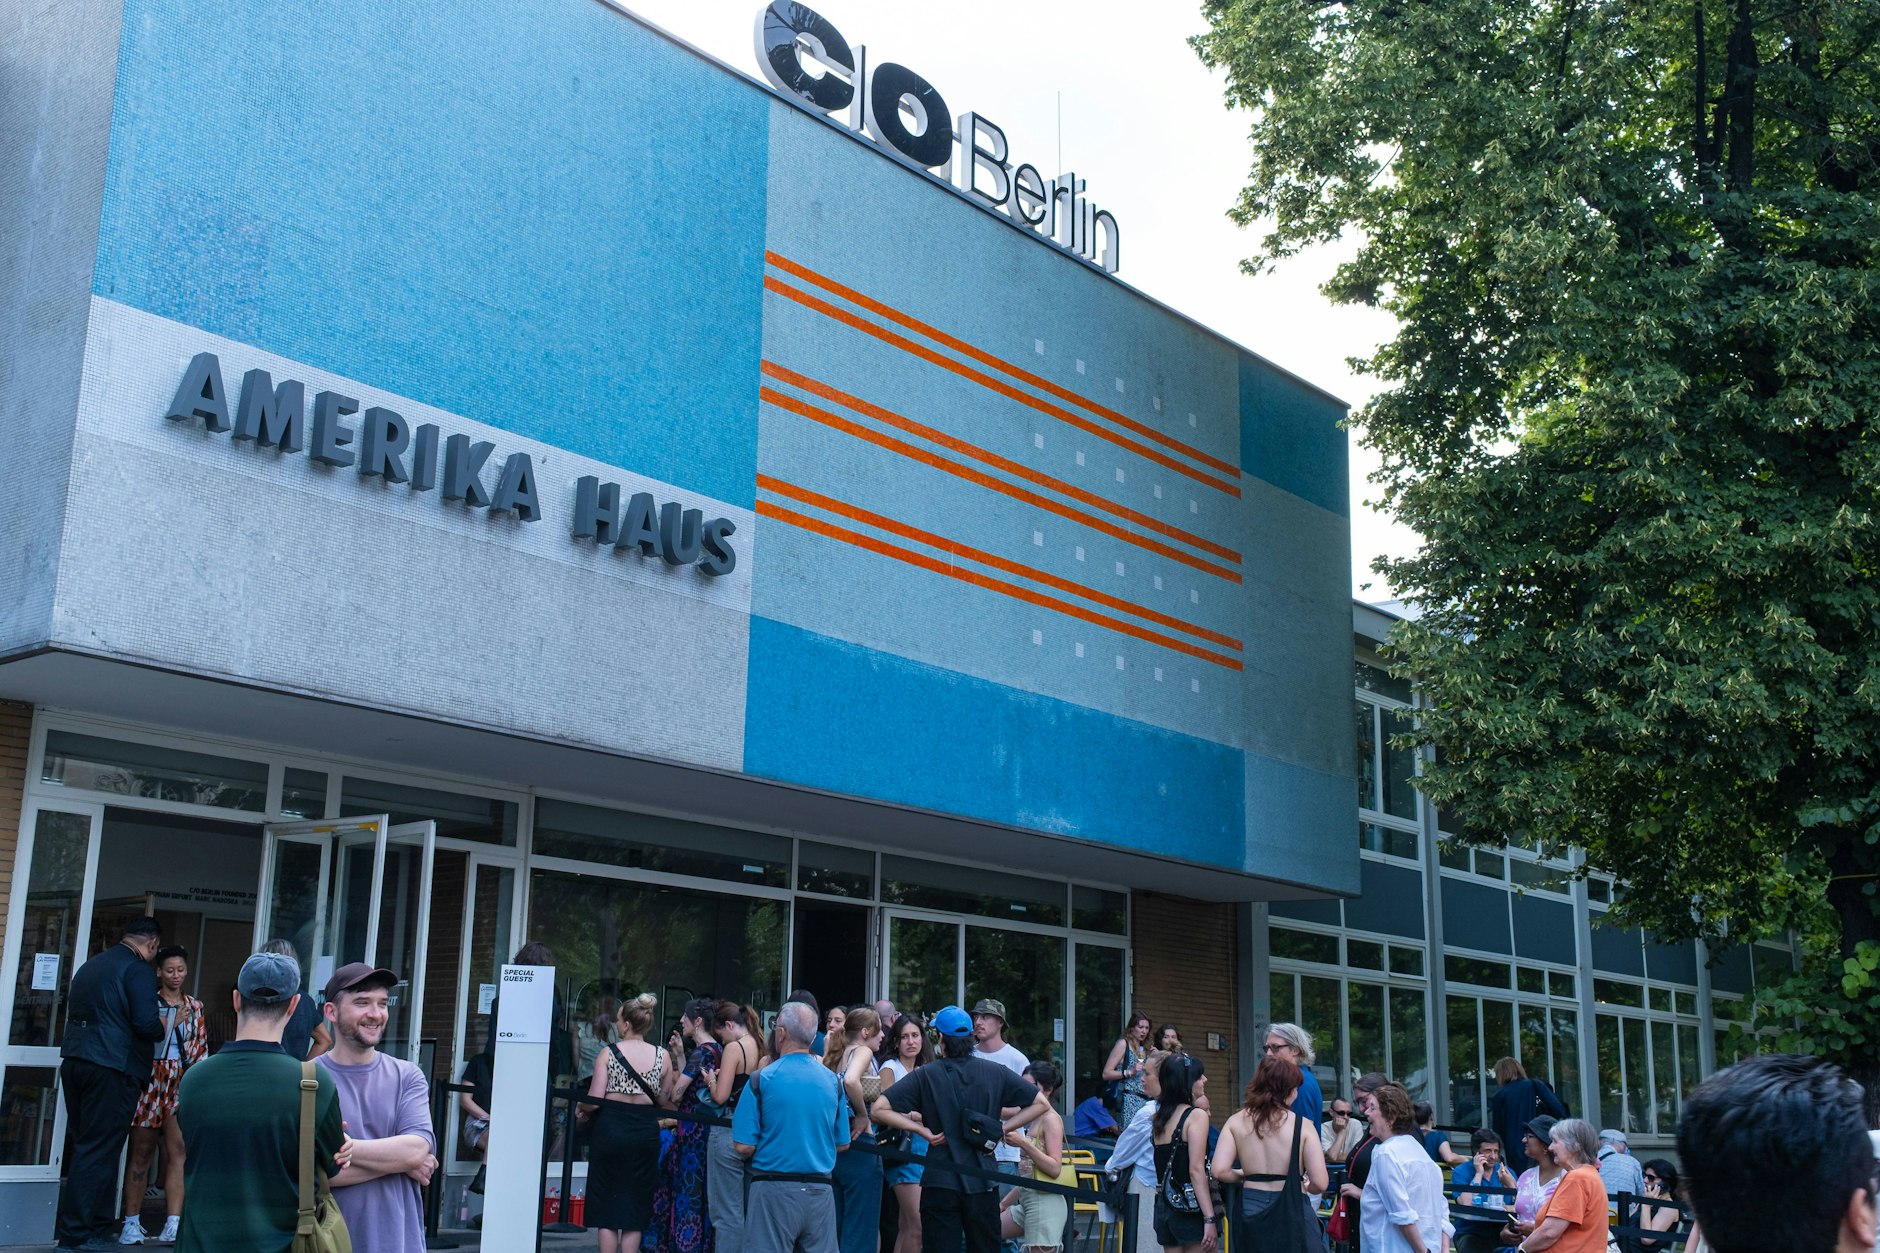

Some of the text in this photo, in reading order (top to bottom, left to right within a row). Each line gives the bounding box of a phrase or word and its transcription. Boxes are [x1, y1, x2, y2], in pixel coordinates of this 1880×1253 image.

[957, 111, 1120, 274] Berlin
[165, 351, 738, 577] AMERIKA HAUS
[201, 888, 220, 896] BERLIN
